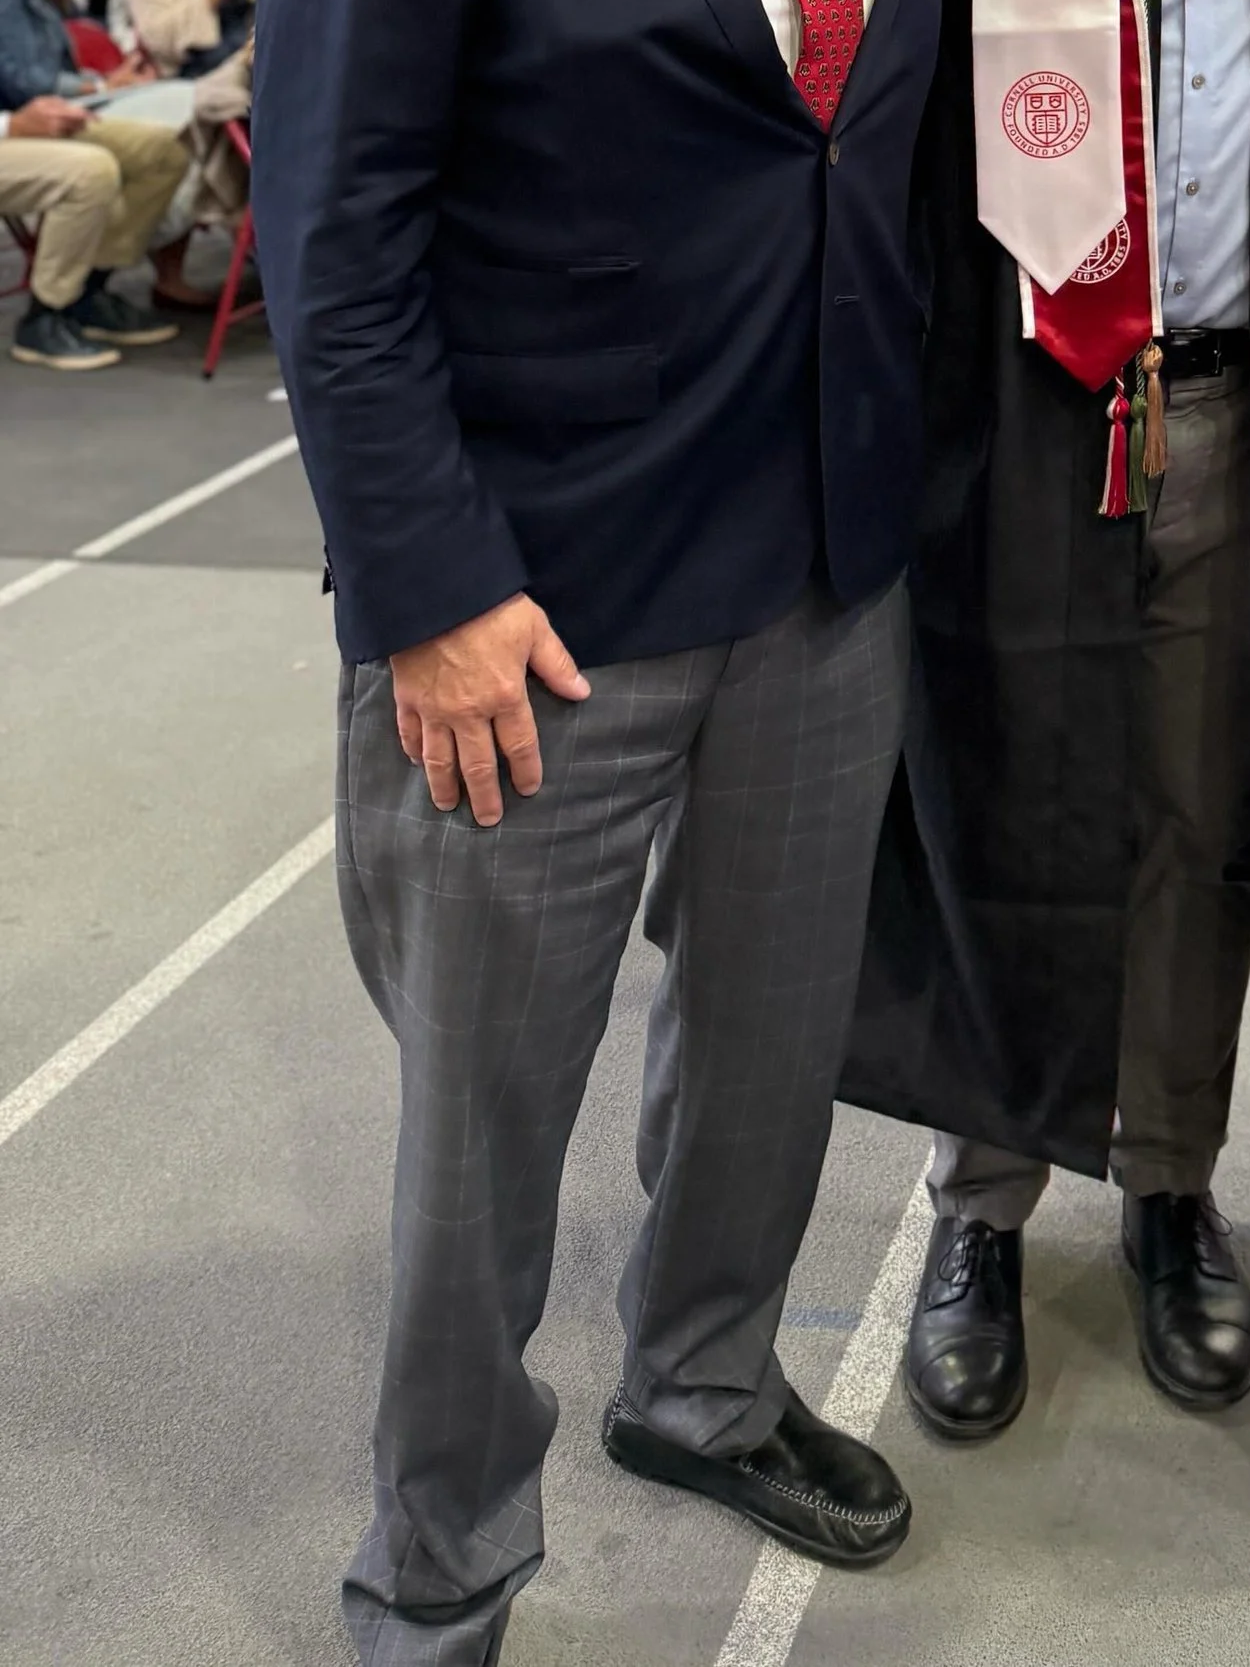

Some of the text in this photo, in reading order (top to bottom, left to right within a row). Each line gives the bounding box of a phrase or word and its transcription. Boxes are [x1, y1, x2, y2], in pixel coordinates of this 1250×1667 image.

[1005, 75, 1087, 117] CORNELL UNIVERSITY
[1007, 124, 1049, 155] FOUNDED
[1070, 122, 1086, 143] 1865
